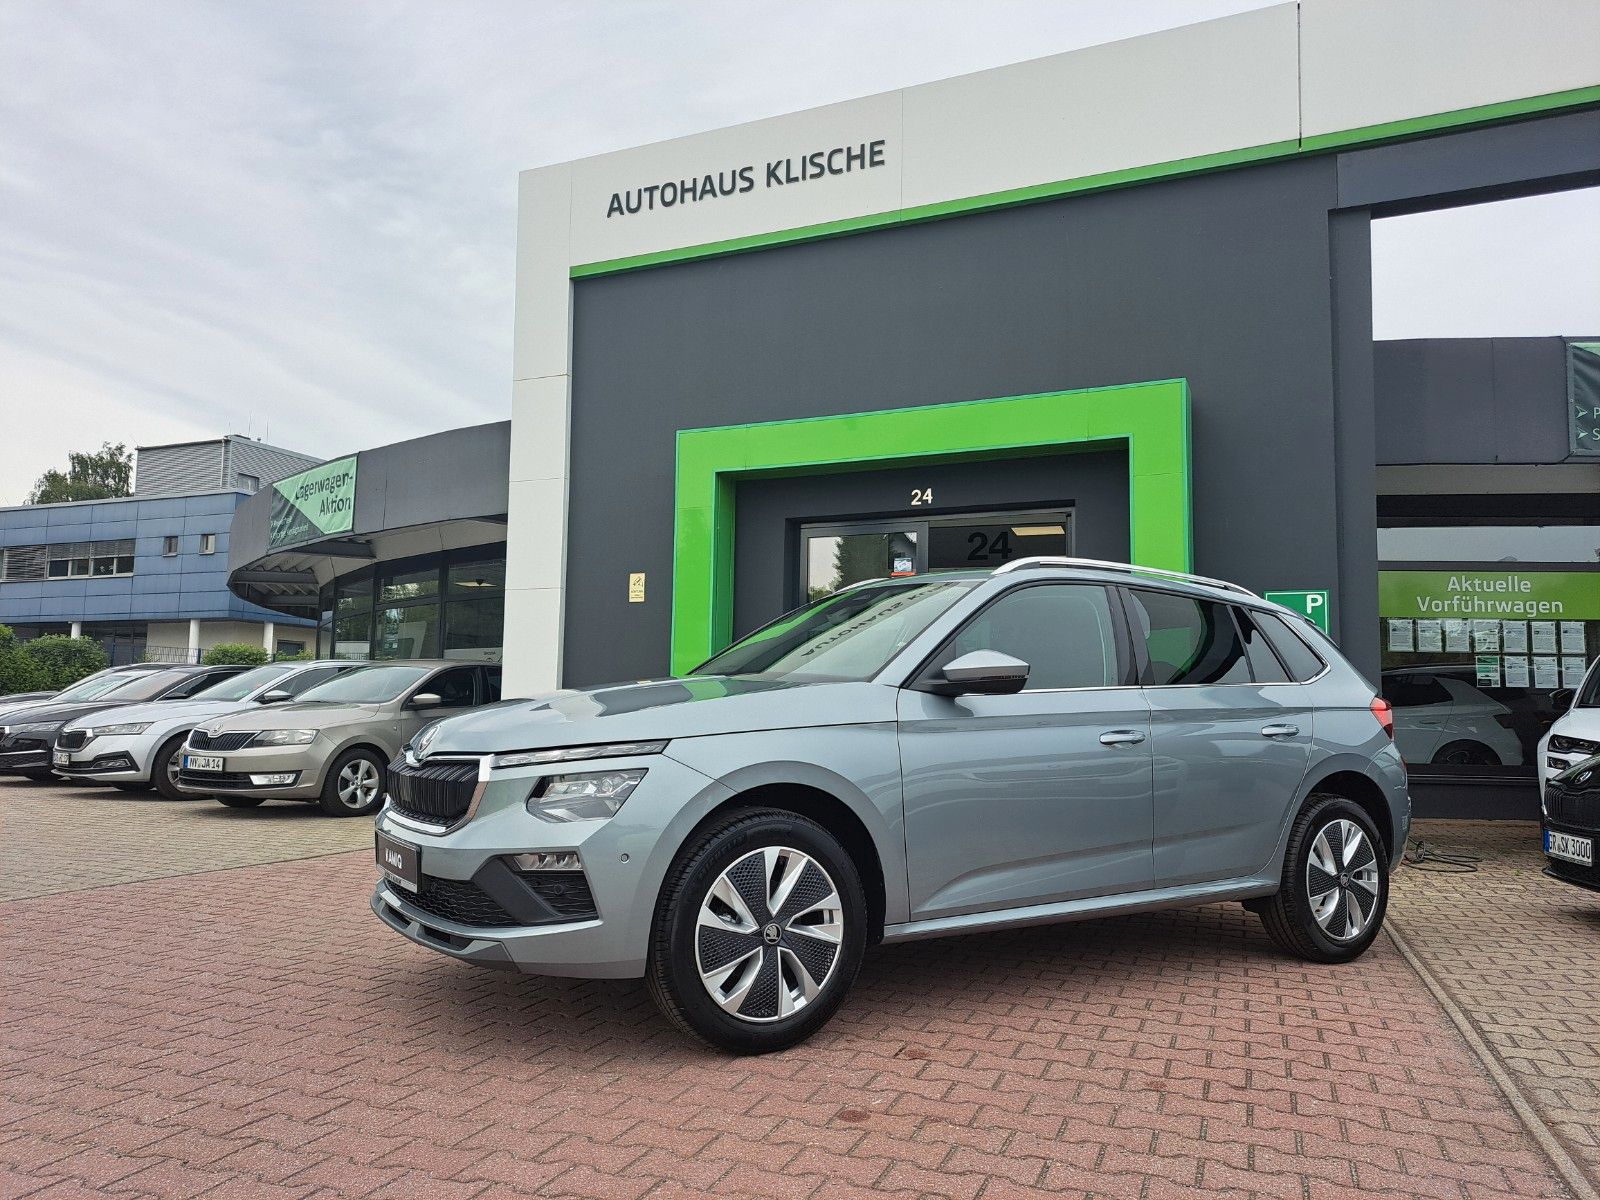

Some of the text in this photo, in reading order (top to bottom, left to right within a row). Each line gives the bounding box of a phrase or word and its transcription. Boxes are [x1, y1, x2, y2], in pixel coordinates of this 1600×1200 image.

[606, 139, 886, 219] AUTOHAUS KLISCHE
[318, 495, 351, 517] Aktion
[911, 488, 933, 506] 24
[967, 531, 1013, 561] 24
[1447, 575, 1532, 593] Aktuelle
[1306, 594, 1323, 614] P
[1416, 594, 1563, 618] Vorführwagen
[211, 758, 220, 769] 14
[1561, 837, 1570, 854] SK
[1572, 838, 1591, 859] 3000
